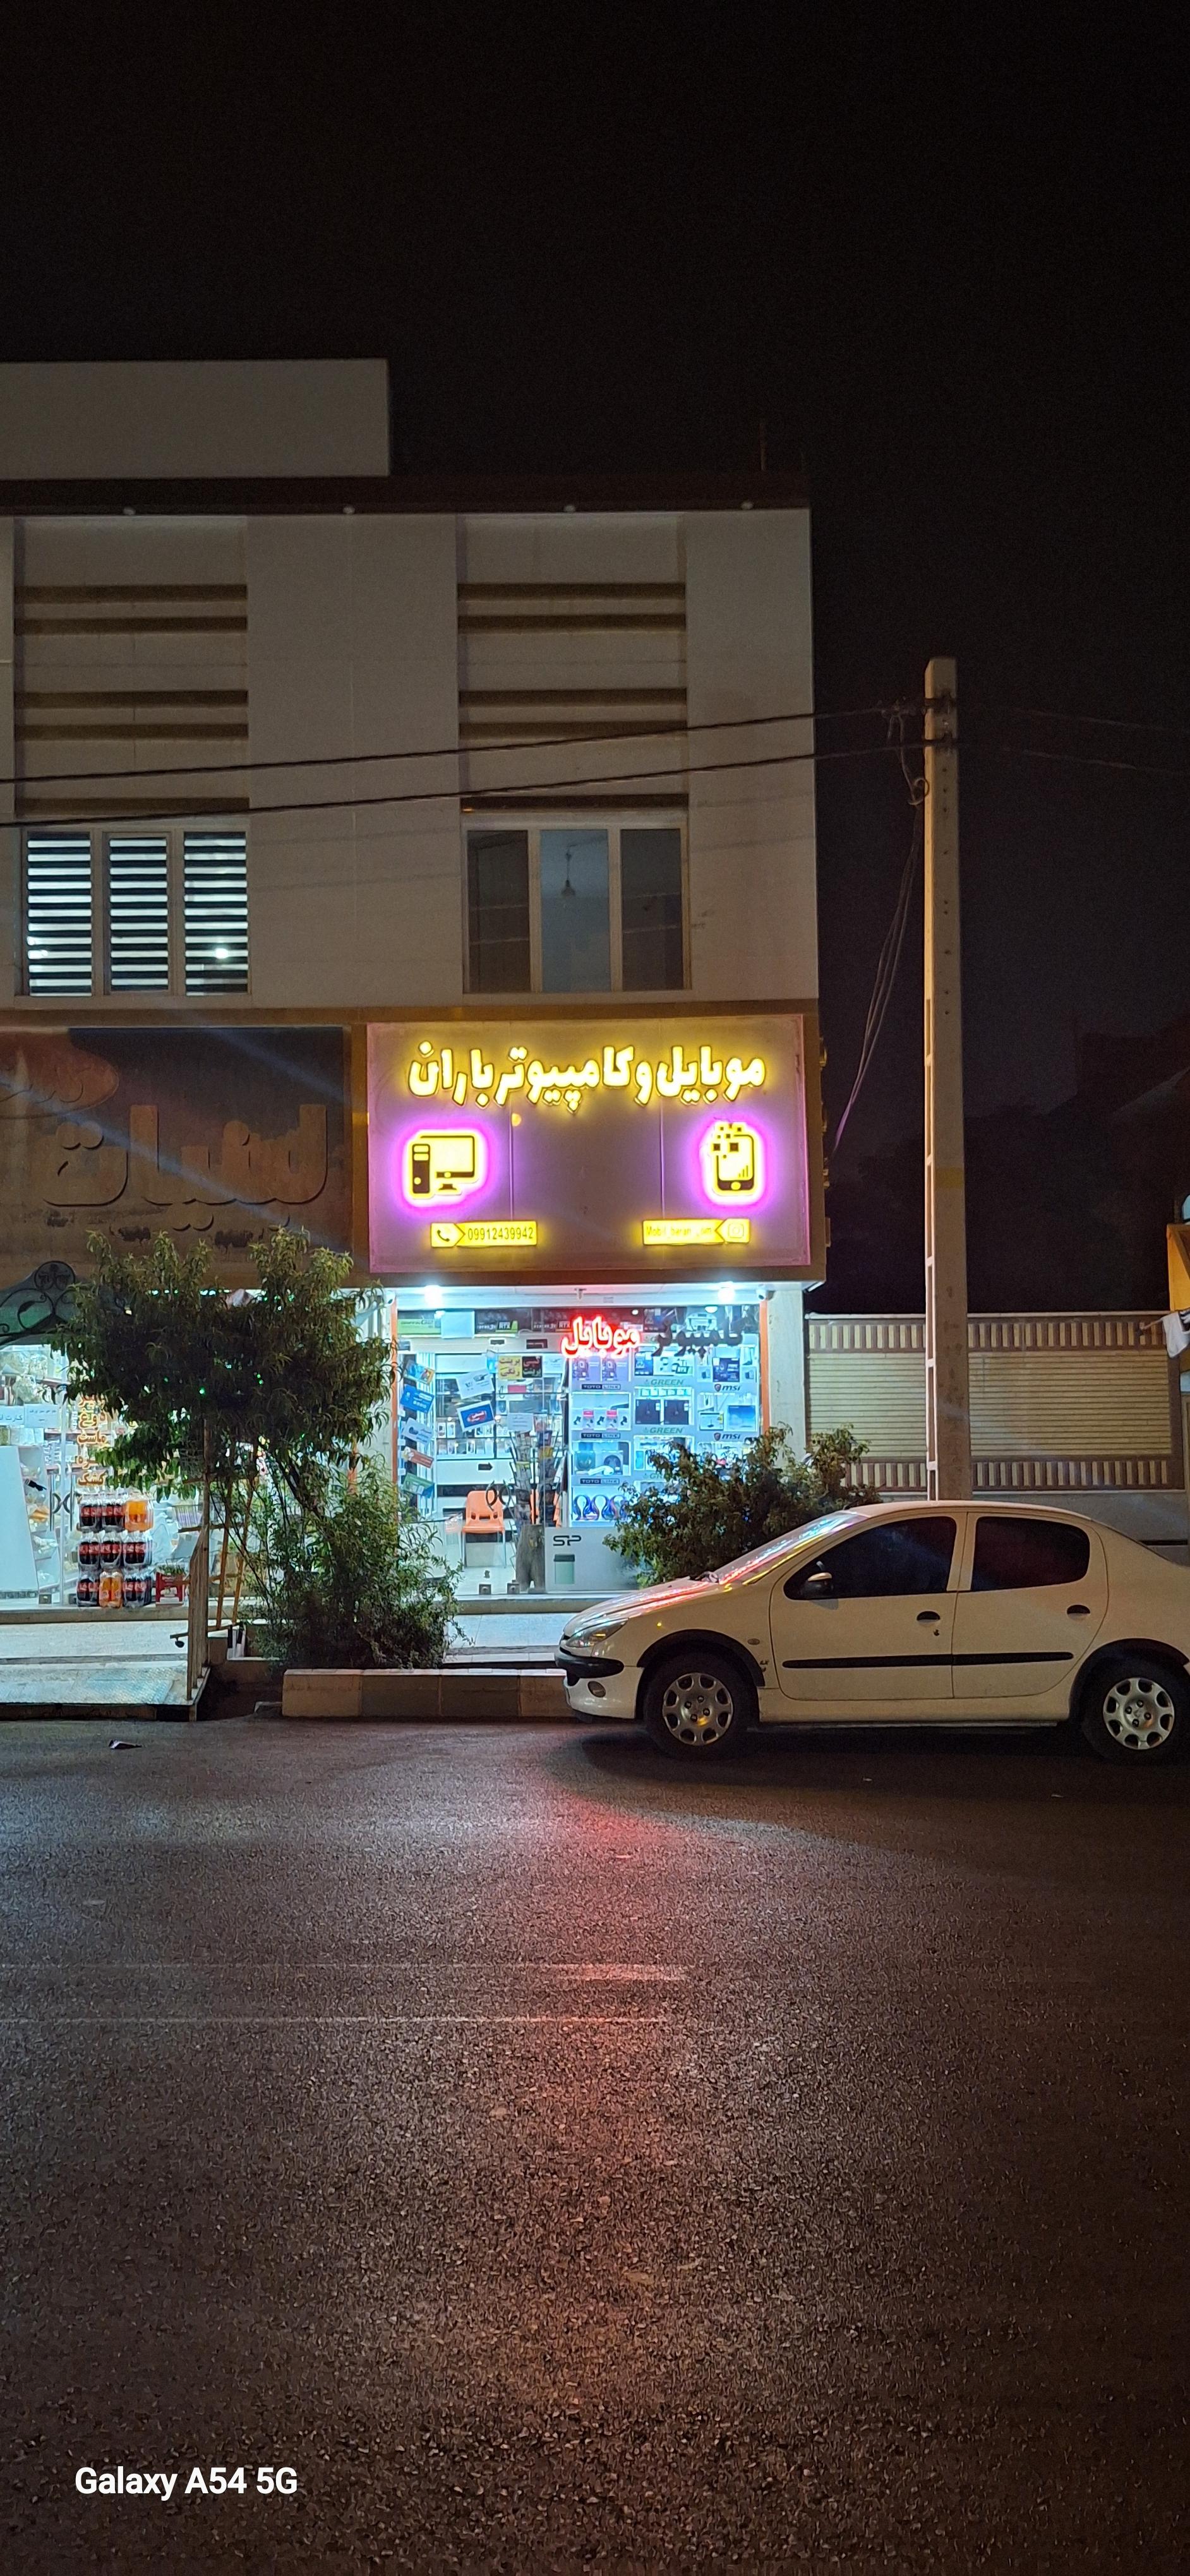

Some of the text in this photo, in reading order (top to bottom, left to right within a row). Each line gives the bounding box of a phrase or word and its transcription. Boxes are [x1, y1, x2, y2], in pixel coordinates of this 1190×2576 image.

[409, 1041, 765, 1113] موبایل و کامپیوتر باران
[468, 1227, 533, 1240] 09912439942
[562, 1316, 640, 1357] موبایل
[77, 1431, 107, 1444] ماست
[77, 1472, 106, 1486] کشک
[553, 1535, 582, 1546] SP
